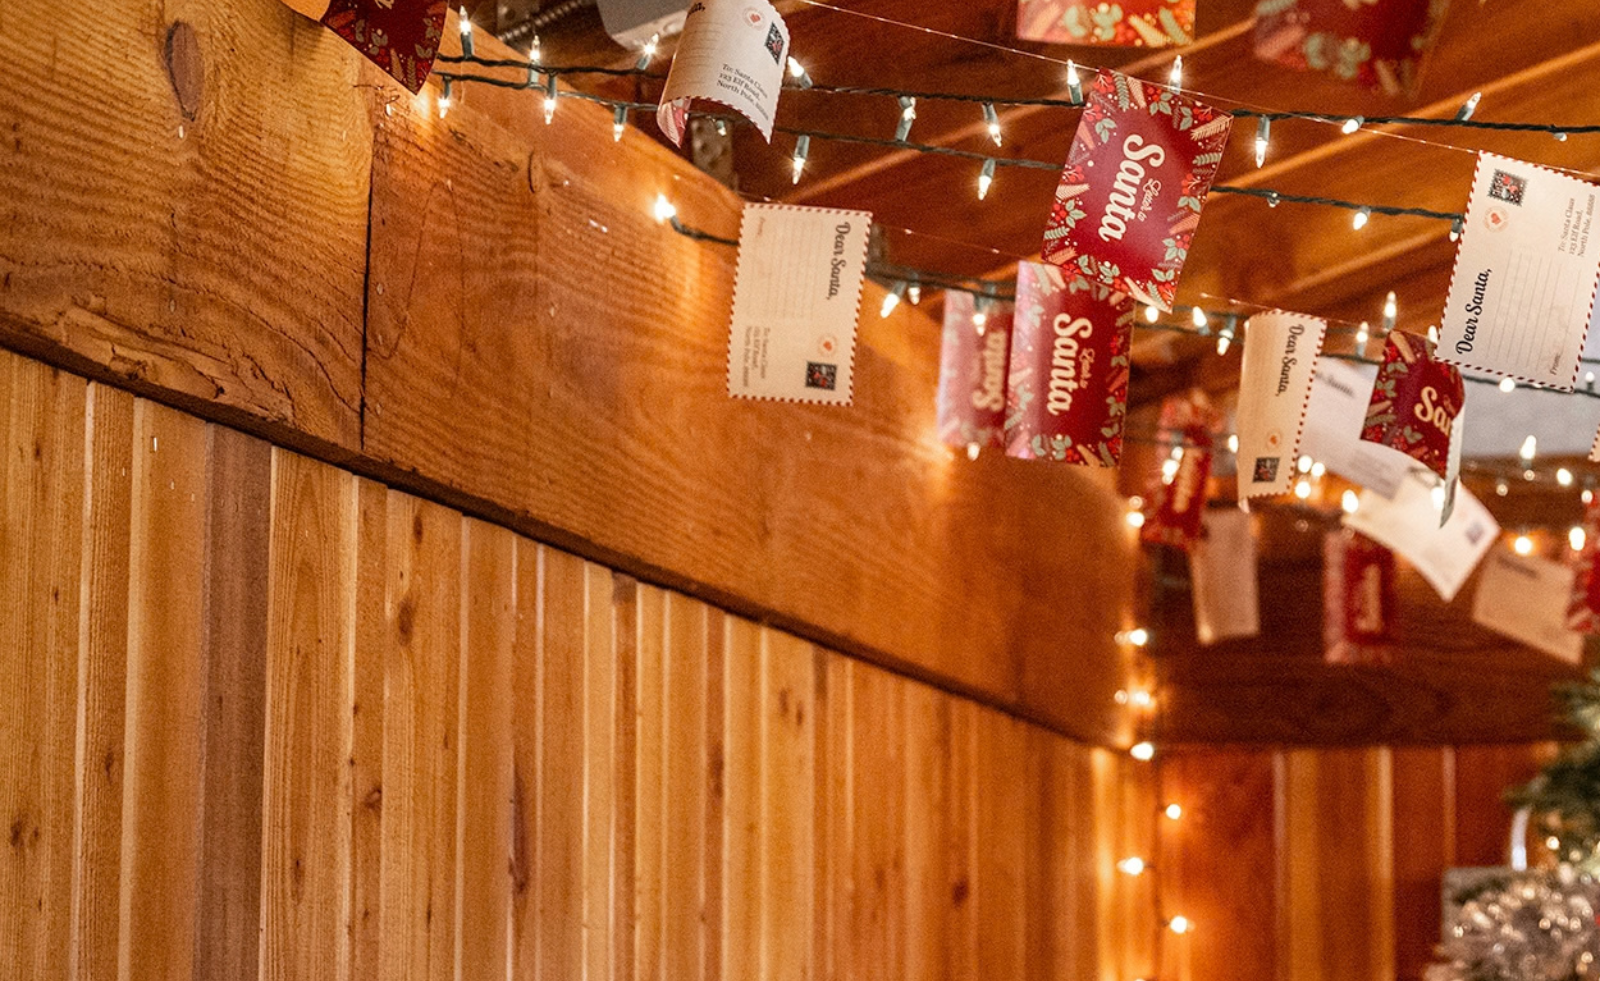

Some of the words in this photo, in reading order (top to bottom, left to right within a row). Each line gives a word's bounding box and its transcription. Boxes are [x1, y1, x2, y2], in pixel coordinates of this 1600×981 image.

[1098, 133, 1165, 242] Santa
[835, 221, 851, 256] Dear
[825, 257, 847, 300] Santa,
[1465, 268, 1493, 316] Santa,
[1285, 323, 1305, 355] Dear
[1455, 317, 1479, 355] Dear
[1047, 313, 1093, 415] Santa
[1275, 355, 1298, 397] Santa,
